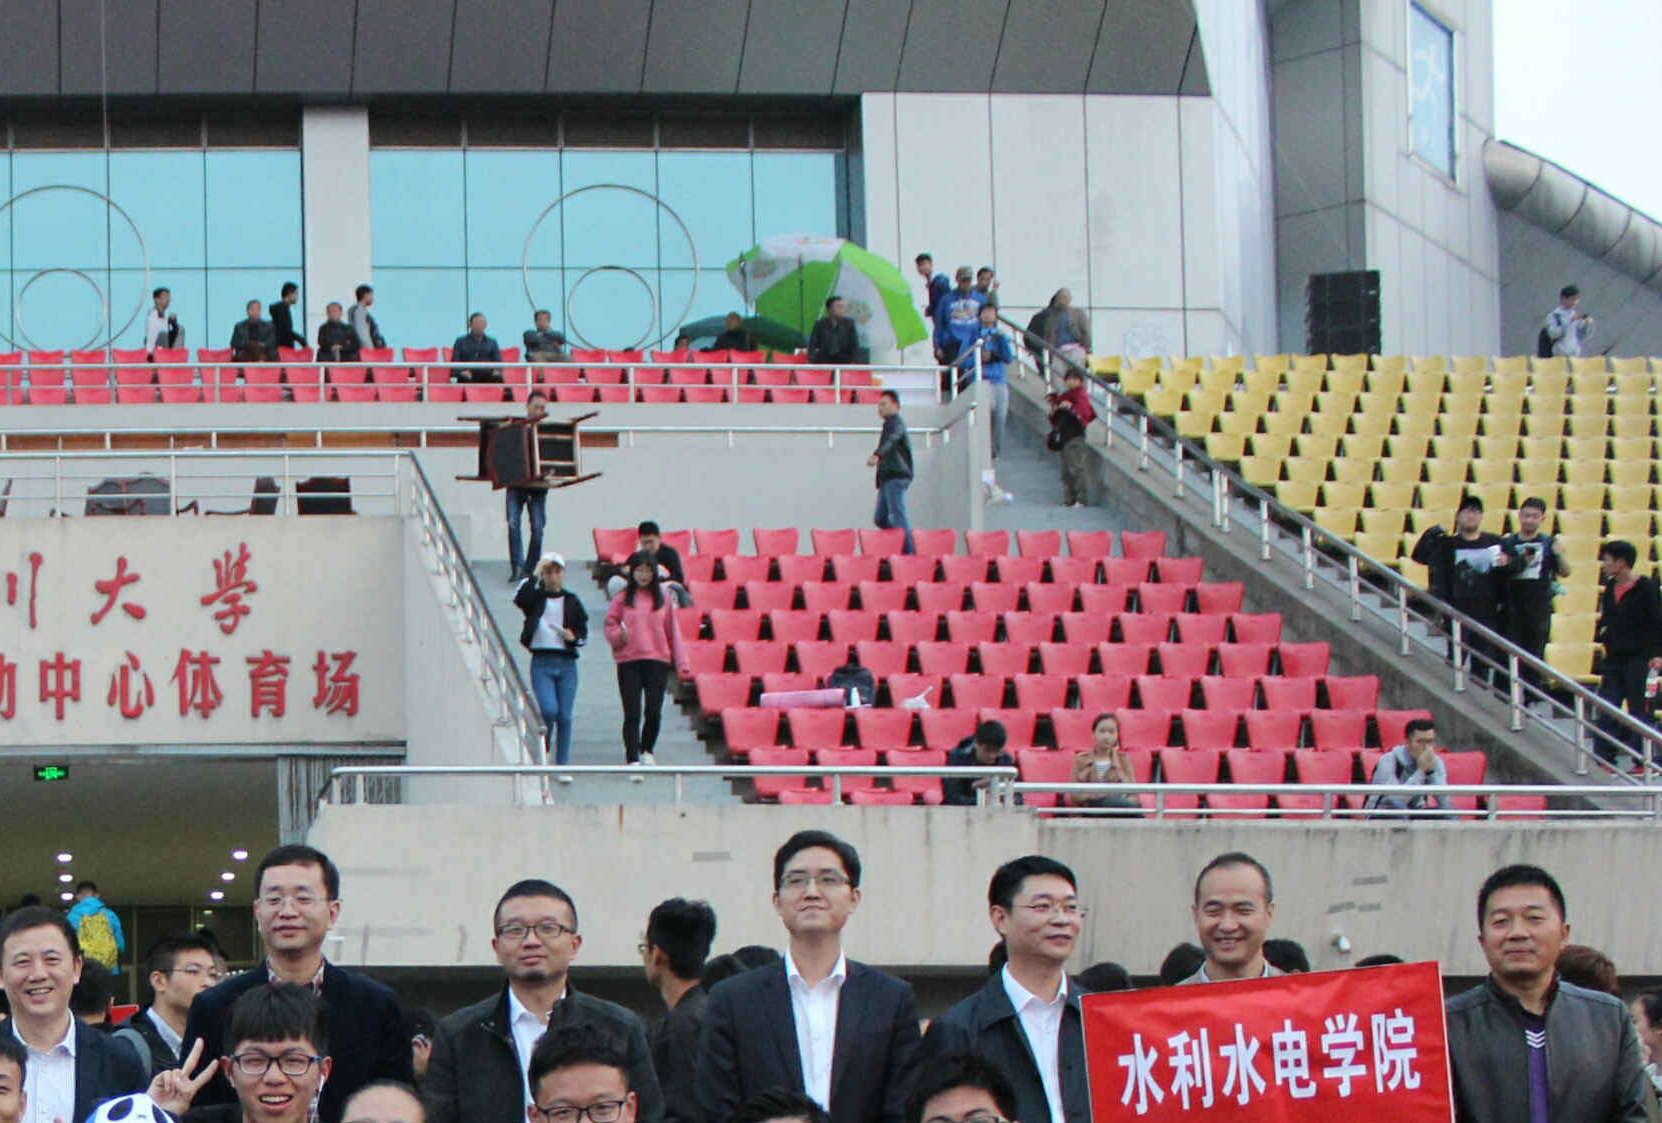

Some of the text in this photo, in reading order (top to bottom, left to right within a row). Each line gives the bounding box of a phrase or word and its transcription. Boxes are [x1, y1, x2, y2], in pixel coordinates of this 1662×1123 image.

[1117, 1007, 1422, 1116] 水利水电学院
